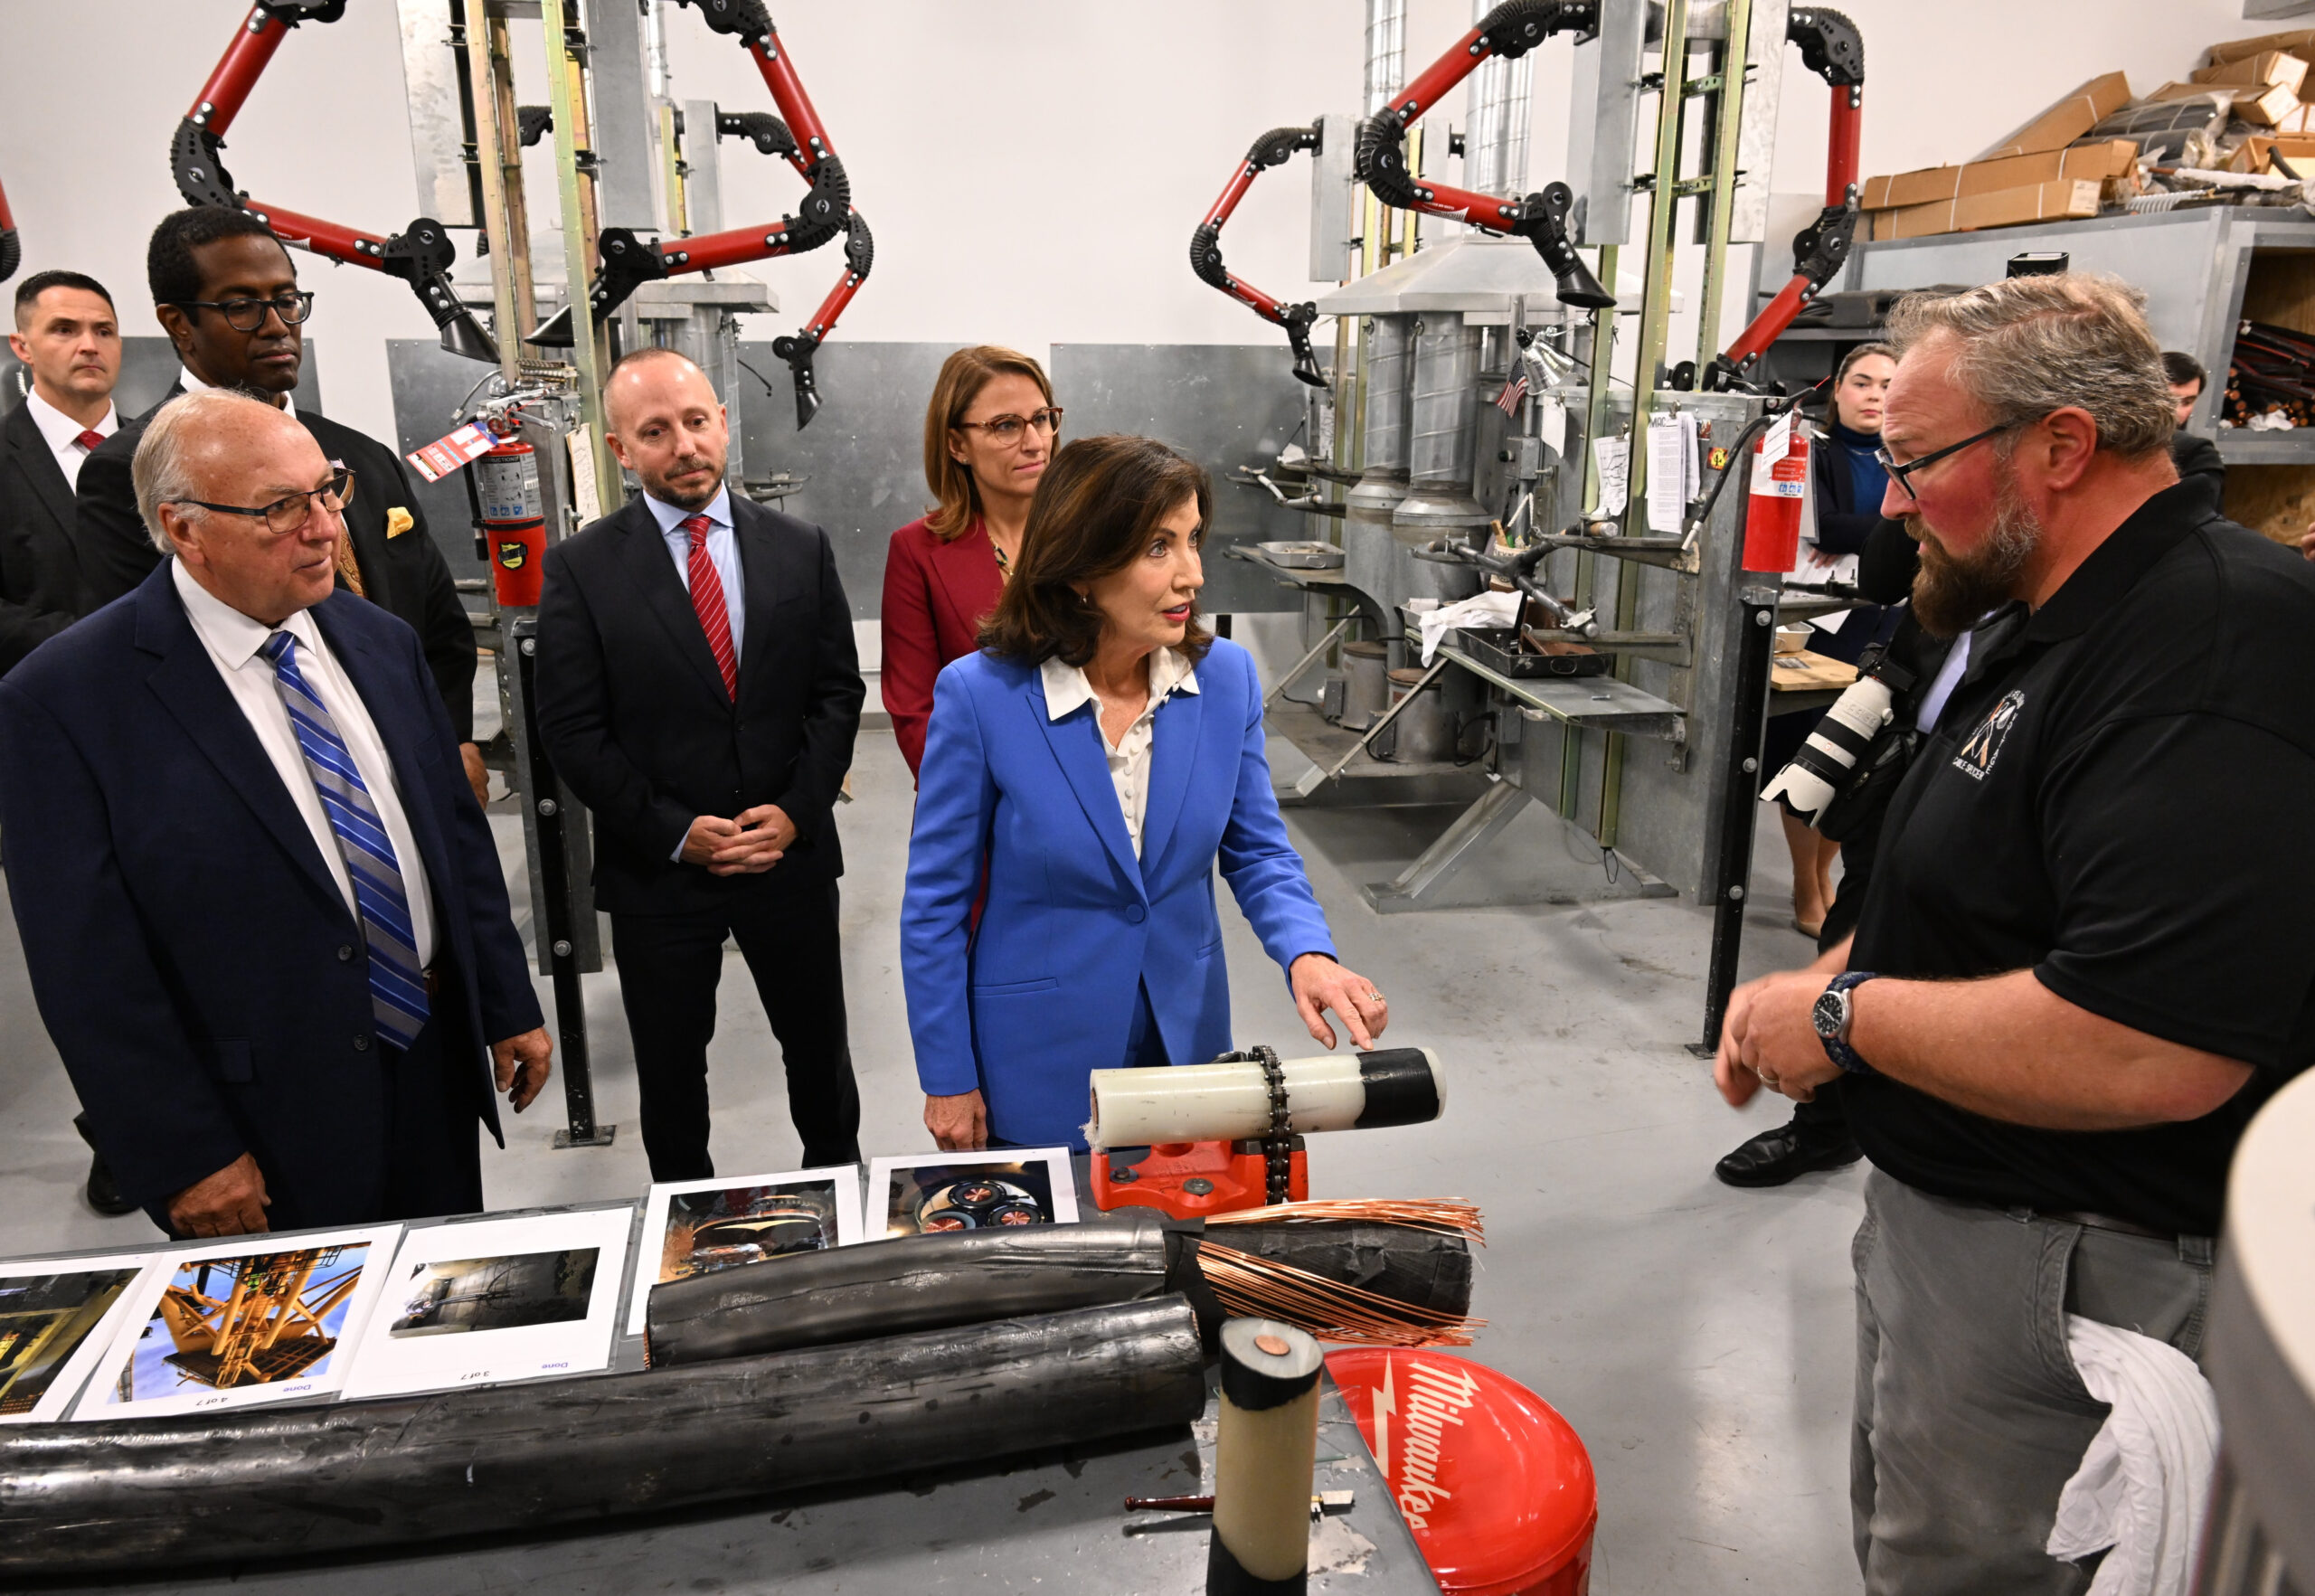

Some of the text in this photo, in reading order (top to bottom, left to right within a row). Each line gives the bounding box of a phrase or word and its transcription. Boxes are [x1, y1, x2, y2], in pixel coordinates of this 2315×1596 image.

[1985, 713, 2018, 775] VOLTAGE
[283, 1384, 311, 1393] Done
[1398, 1363, 1481, 1530] Milwaukee
